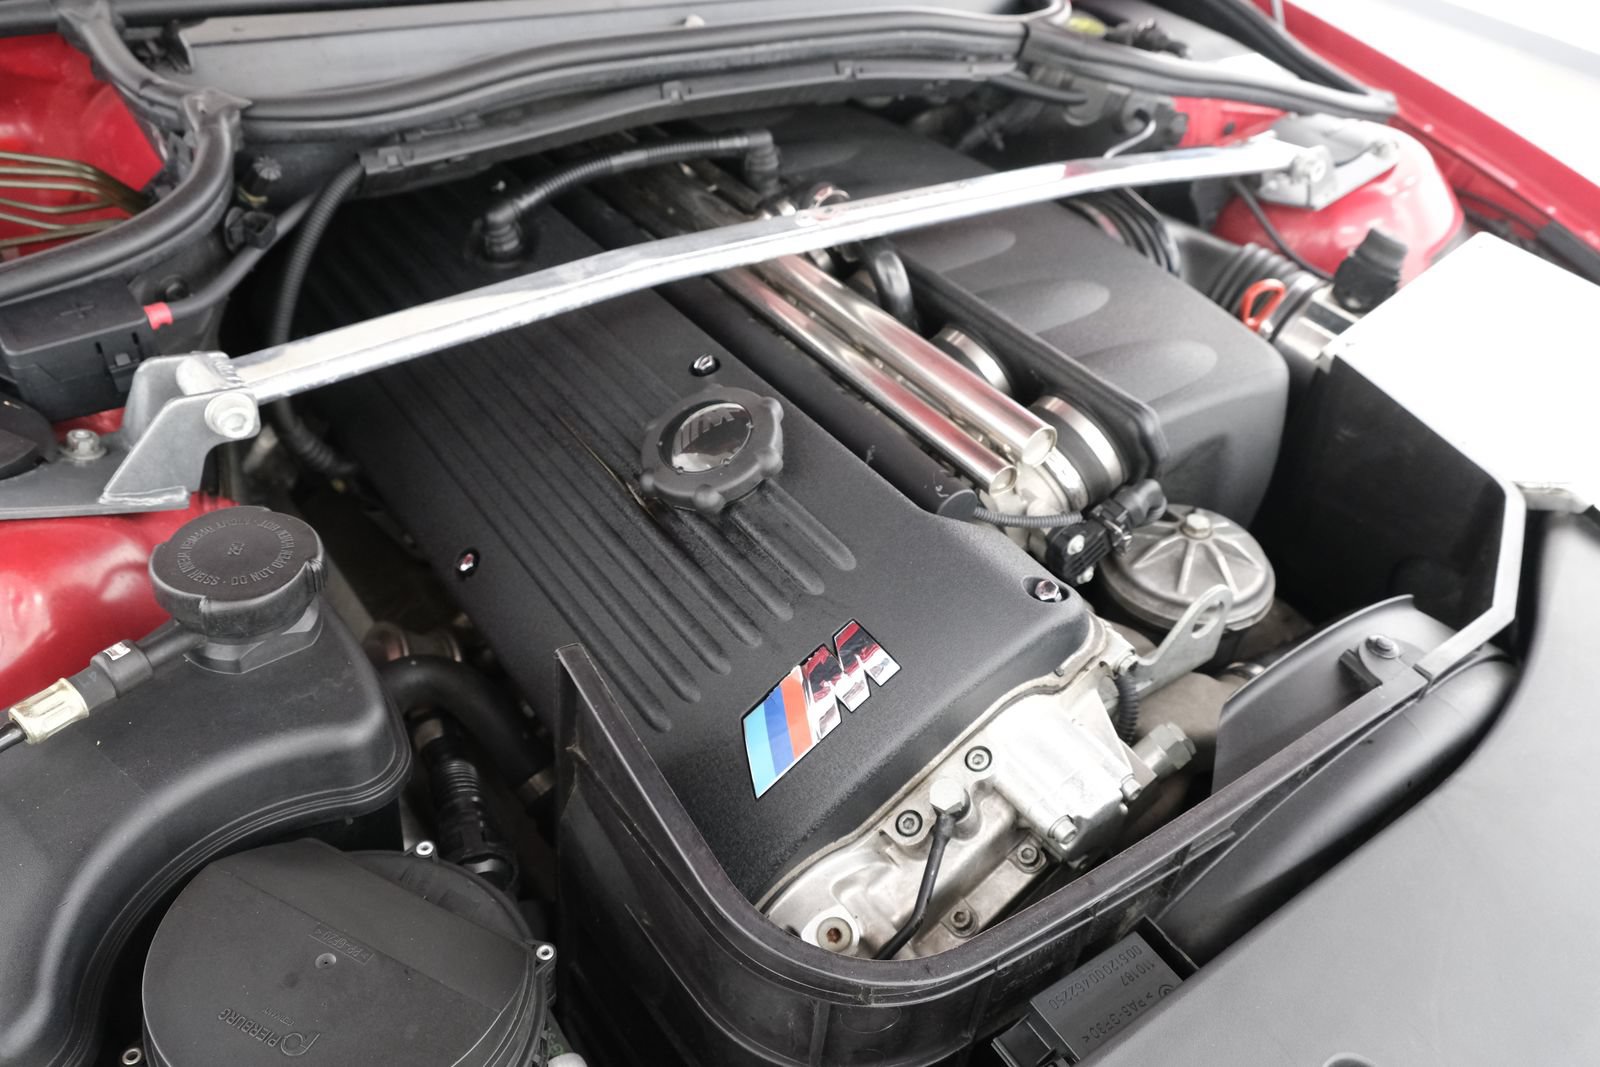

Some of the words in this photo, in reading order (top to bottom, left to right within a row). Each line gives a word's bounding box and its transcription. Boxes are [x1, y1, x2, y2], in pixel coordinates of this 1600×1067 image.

[257, 519, 280, 531] HOT
[271, 550, 294, 569] OPEN
[188, 569, 220, 586] HEISS
[231, 576, 248, 586] DO
[250, 566, 274, 582] NOT
[1120, 959, 1155, 986] 110187
[217, 1007, 282, 1048] PIERBURG
